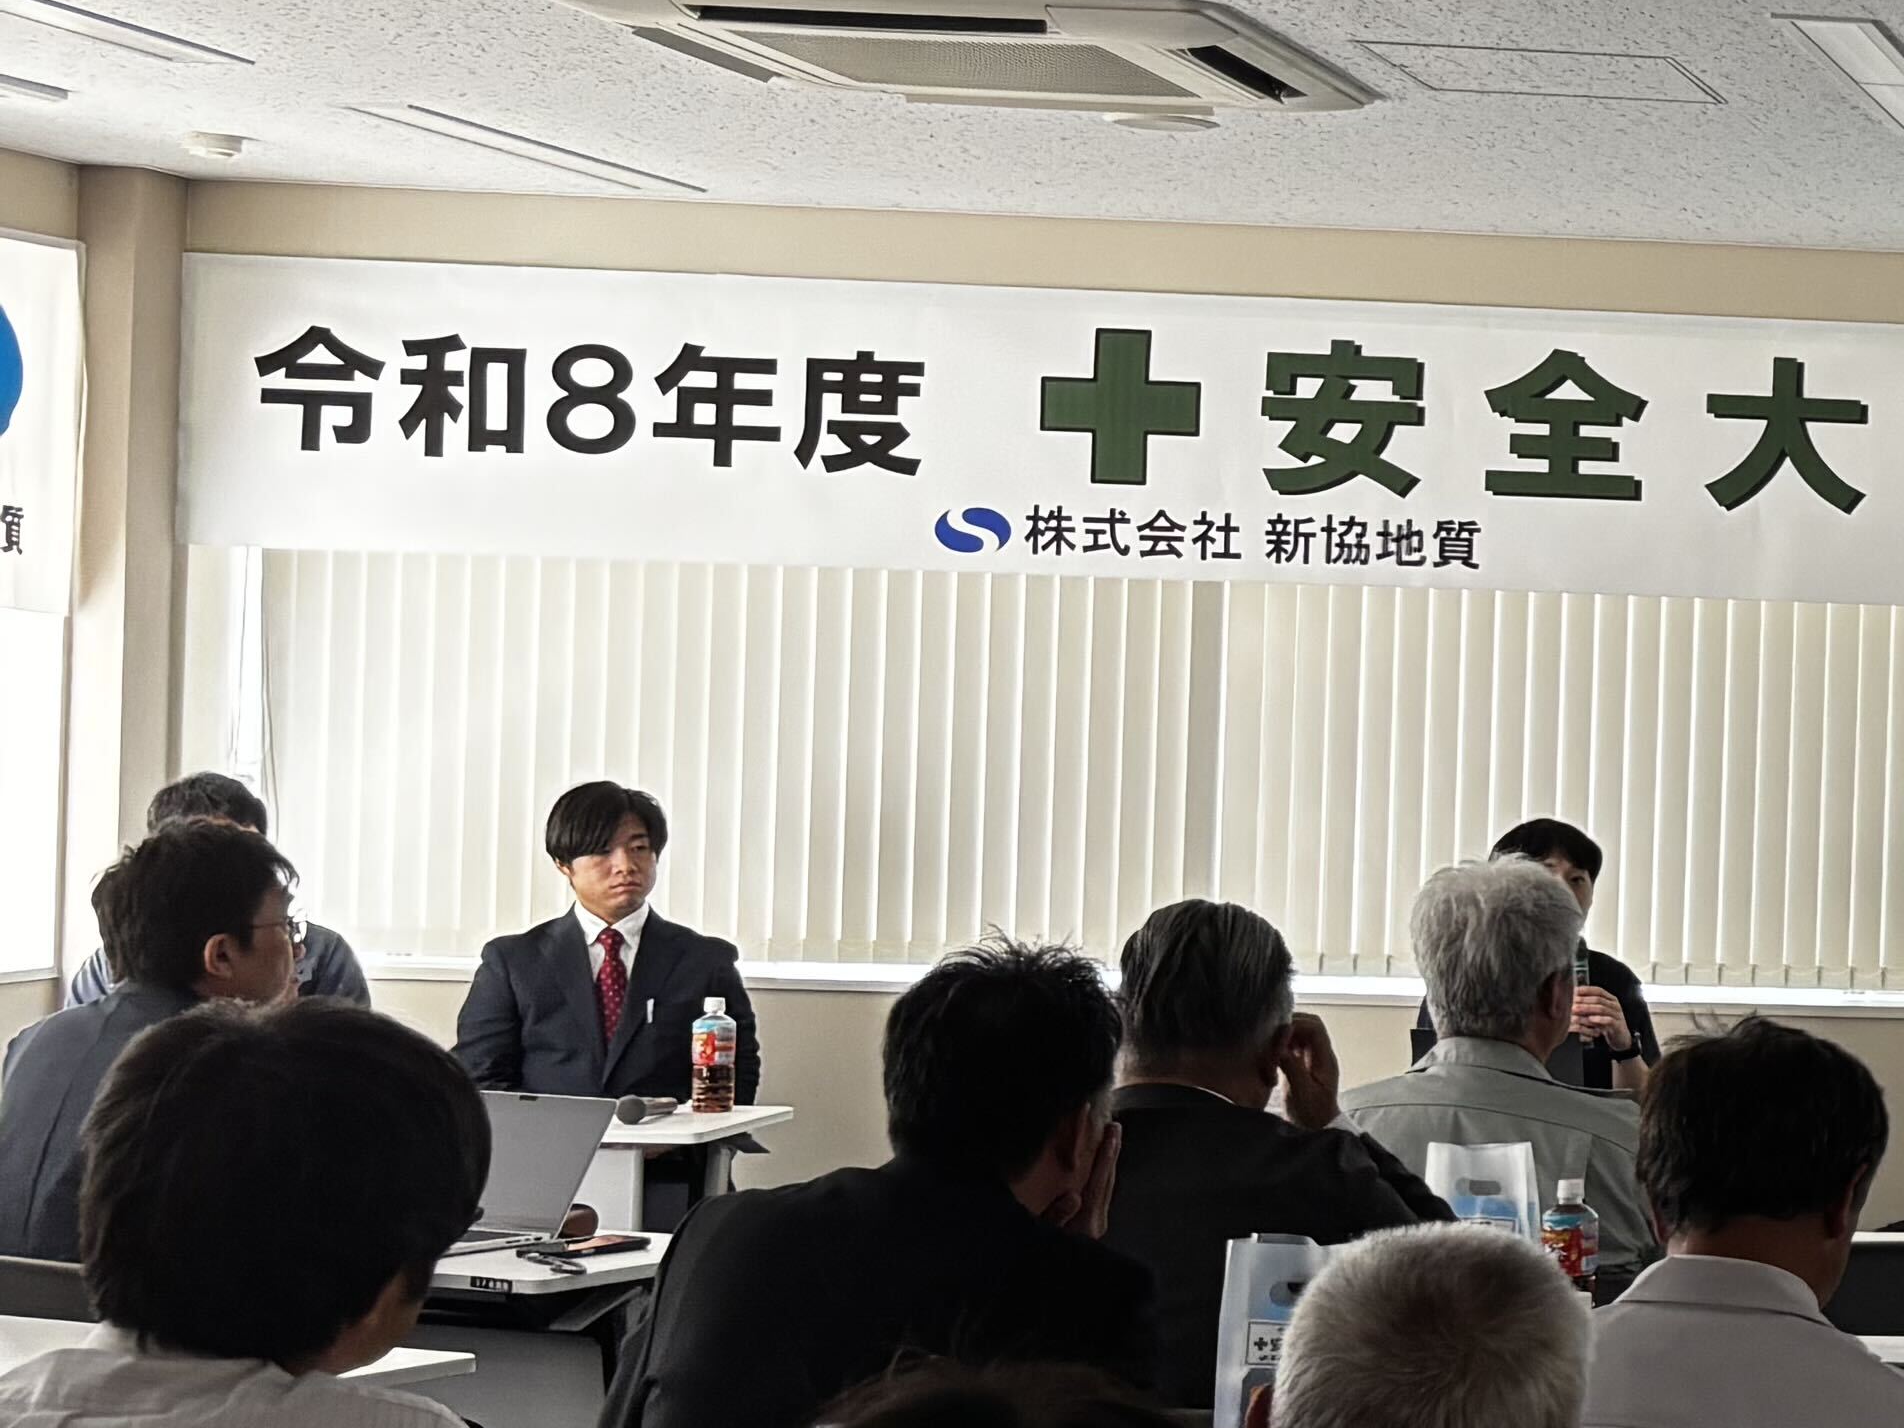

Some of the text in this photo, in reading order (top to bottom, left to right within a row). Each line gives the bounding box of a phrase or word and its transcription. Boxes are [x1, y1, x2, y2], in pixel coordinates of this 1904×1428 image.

[253, 325, 925, 477] 令和8年度
[1024, 504, 1482, 570] 株式会社 新協地質
